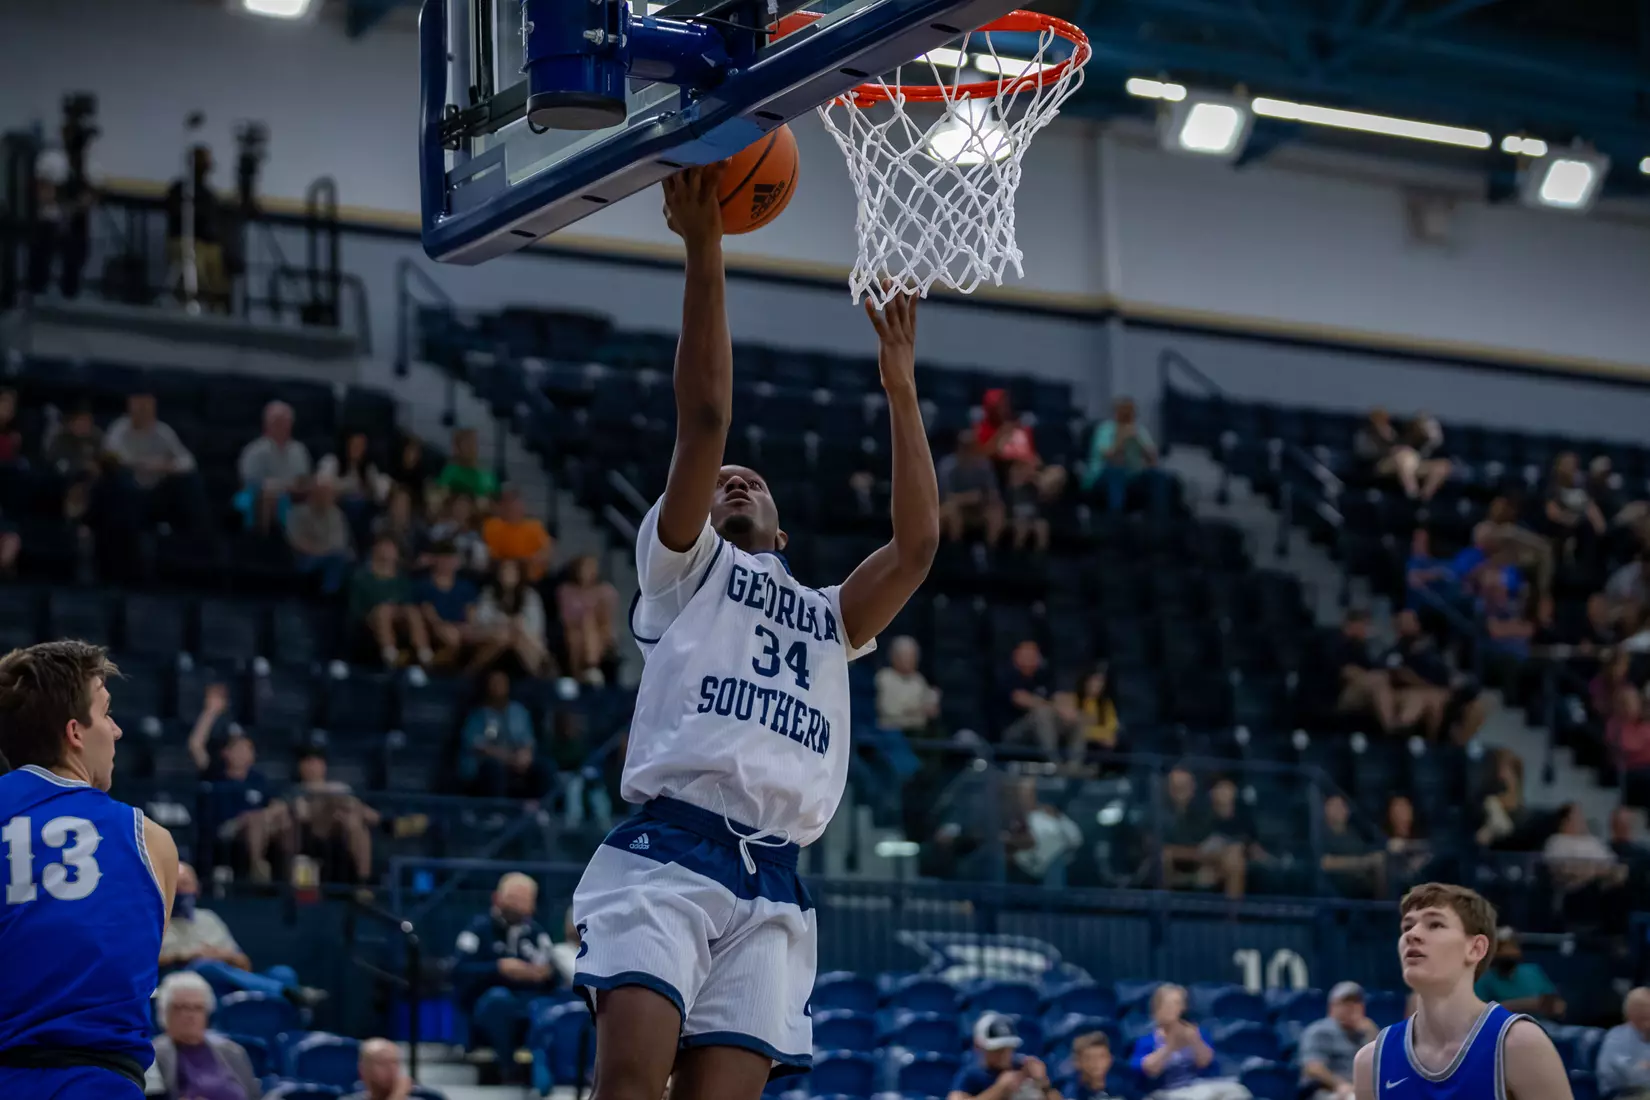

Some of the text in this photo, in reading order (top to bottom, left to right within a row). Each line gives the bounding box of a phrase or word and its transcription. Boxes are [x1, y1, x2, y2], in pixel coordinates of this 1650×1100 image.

[727, 563, 841, 644] GEORGIA
[752, 624, 810, 691] 34
[697, 675, 831, 756] SOUTHERN
[1, 815, 104, 905] 13
[1232, 948, 1310, 995] 10
